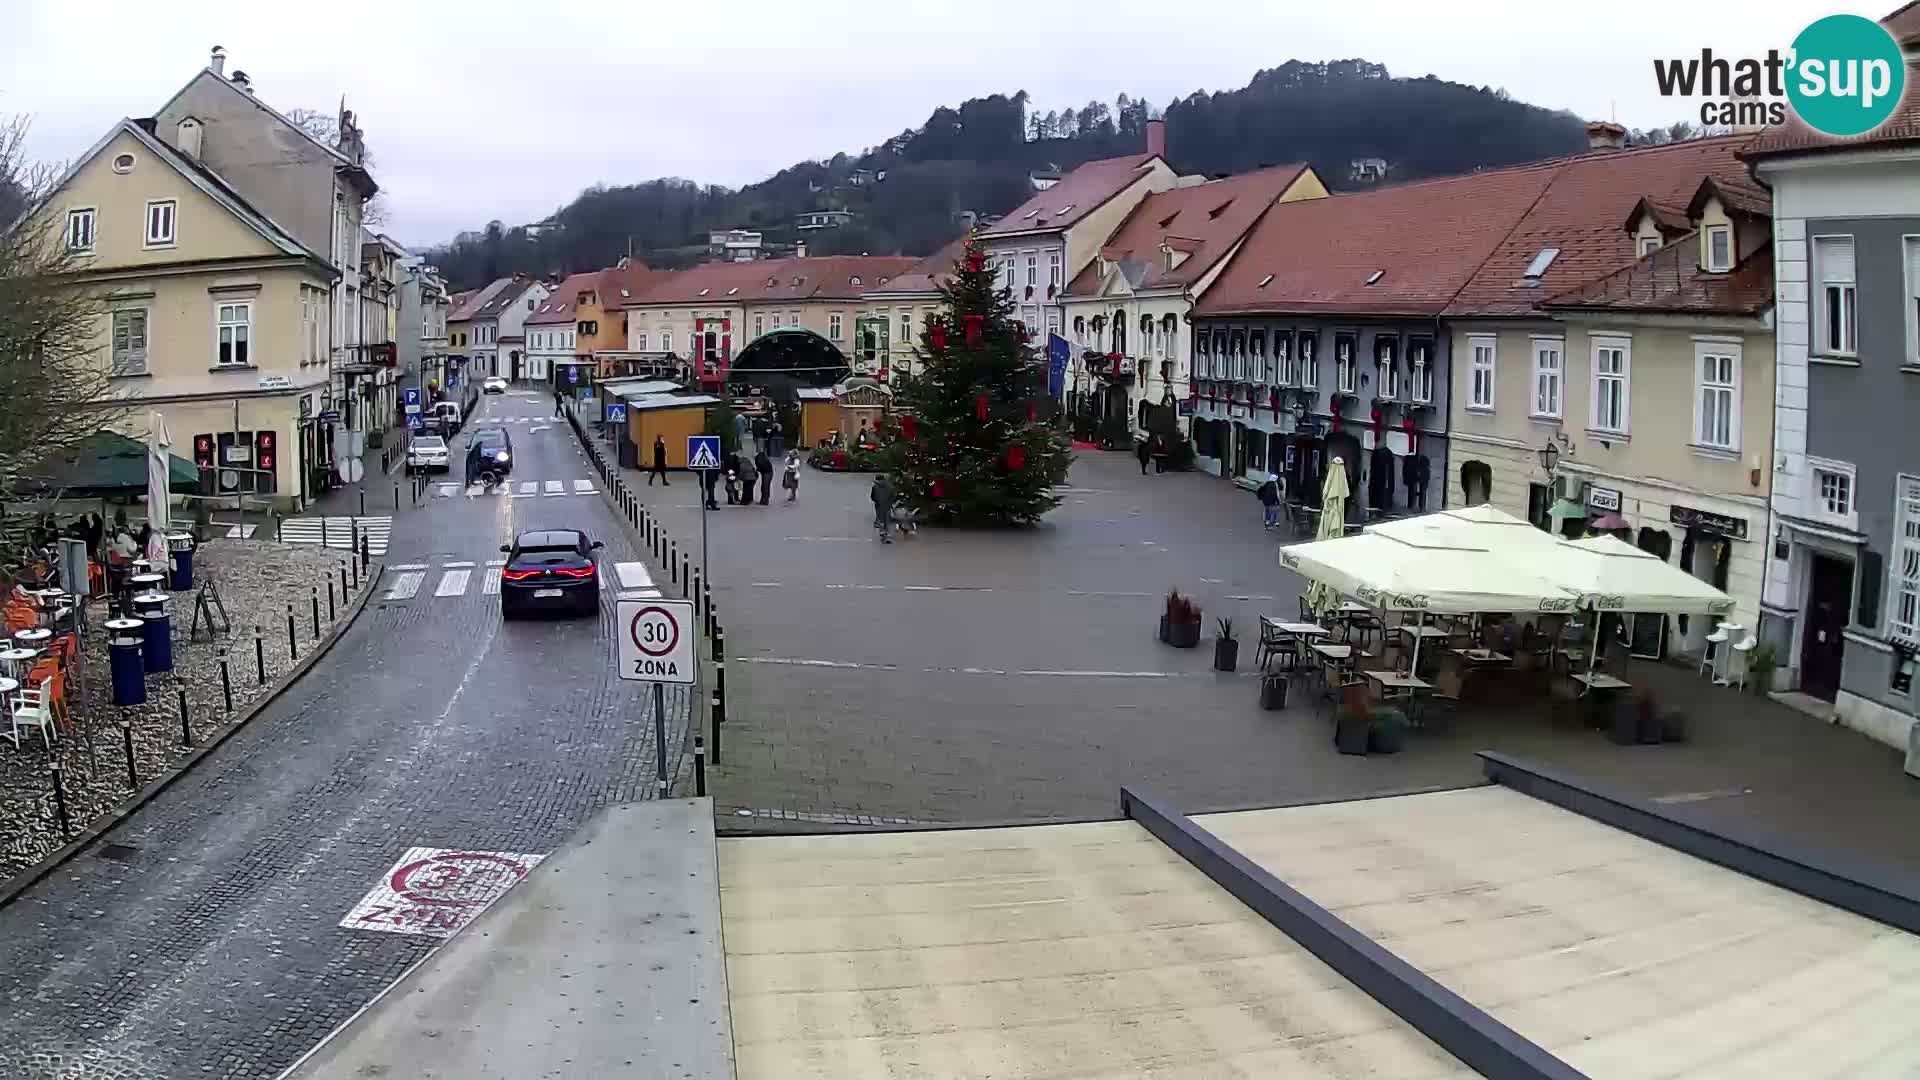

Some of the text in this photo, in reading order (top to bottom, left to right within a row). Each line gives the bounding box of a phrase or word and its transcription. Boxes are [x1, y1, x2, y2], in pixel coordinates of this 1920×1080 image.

[408, 391, 417, 403] P
[643, 622, 668, 643] 30
[634, 659, 679, 677] ZONA
